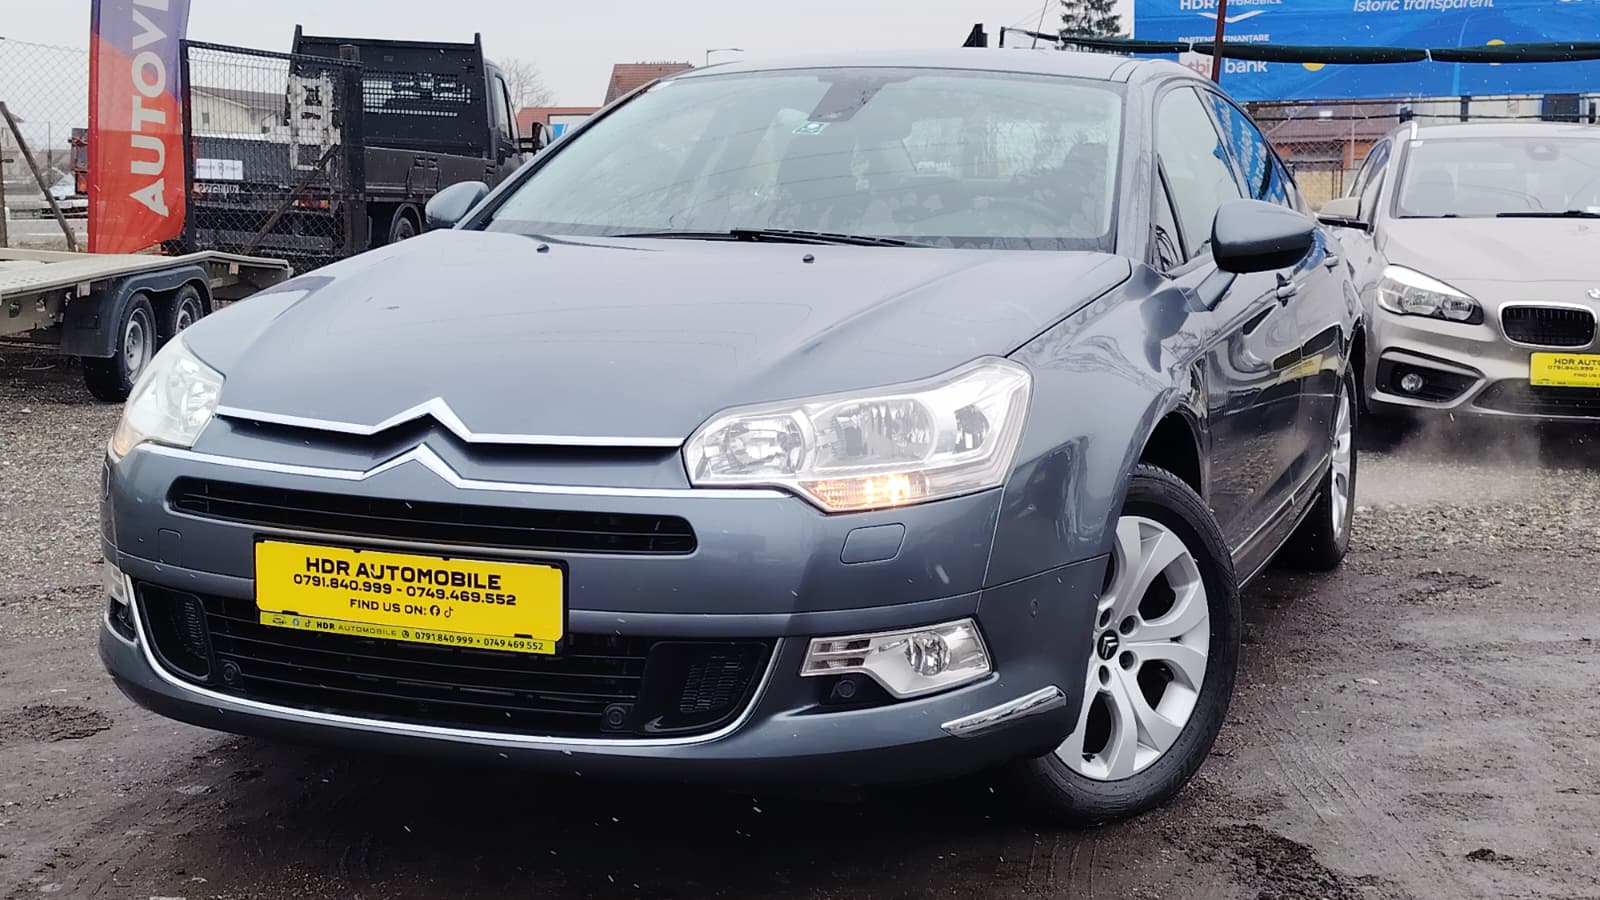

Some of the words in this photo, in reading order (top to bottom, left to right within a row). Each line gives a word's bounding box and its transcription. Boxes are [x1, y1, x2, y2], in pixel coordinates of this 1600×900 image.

[1180, 0, 1214, 10] HDR
[1353, 0, 1400, 12] Istoric
[1403, 0, 1494, 12] transparent
[1225, 58, 1268, 73] bank
[306, 557, 350, 576] HDR
[356, 562, 501, 590] AUTOMOBILE
[293, 574, 392, 594] 0791.840.999
[406, 585, 516, 606] 0749.469.552
[350, 599, 379, 610] FIND
[383, 602, 401, 613] US
[404, 604, 427, 615] ON:
[316, 621, 335, 630] HDR
[337, 624, 397, 636] AUTOMOBILE
